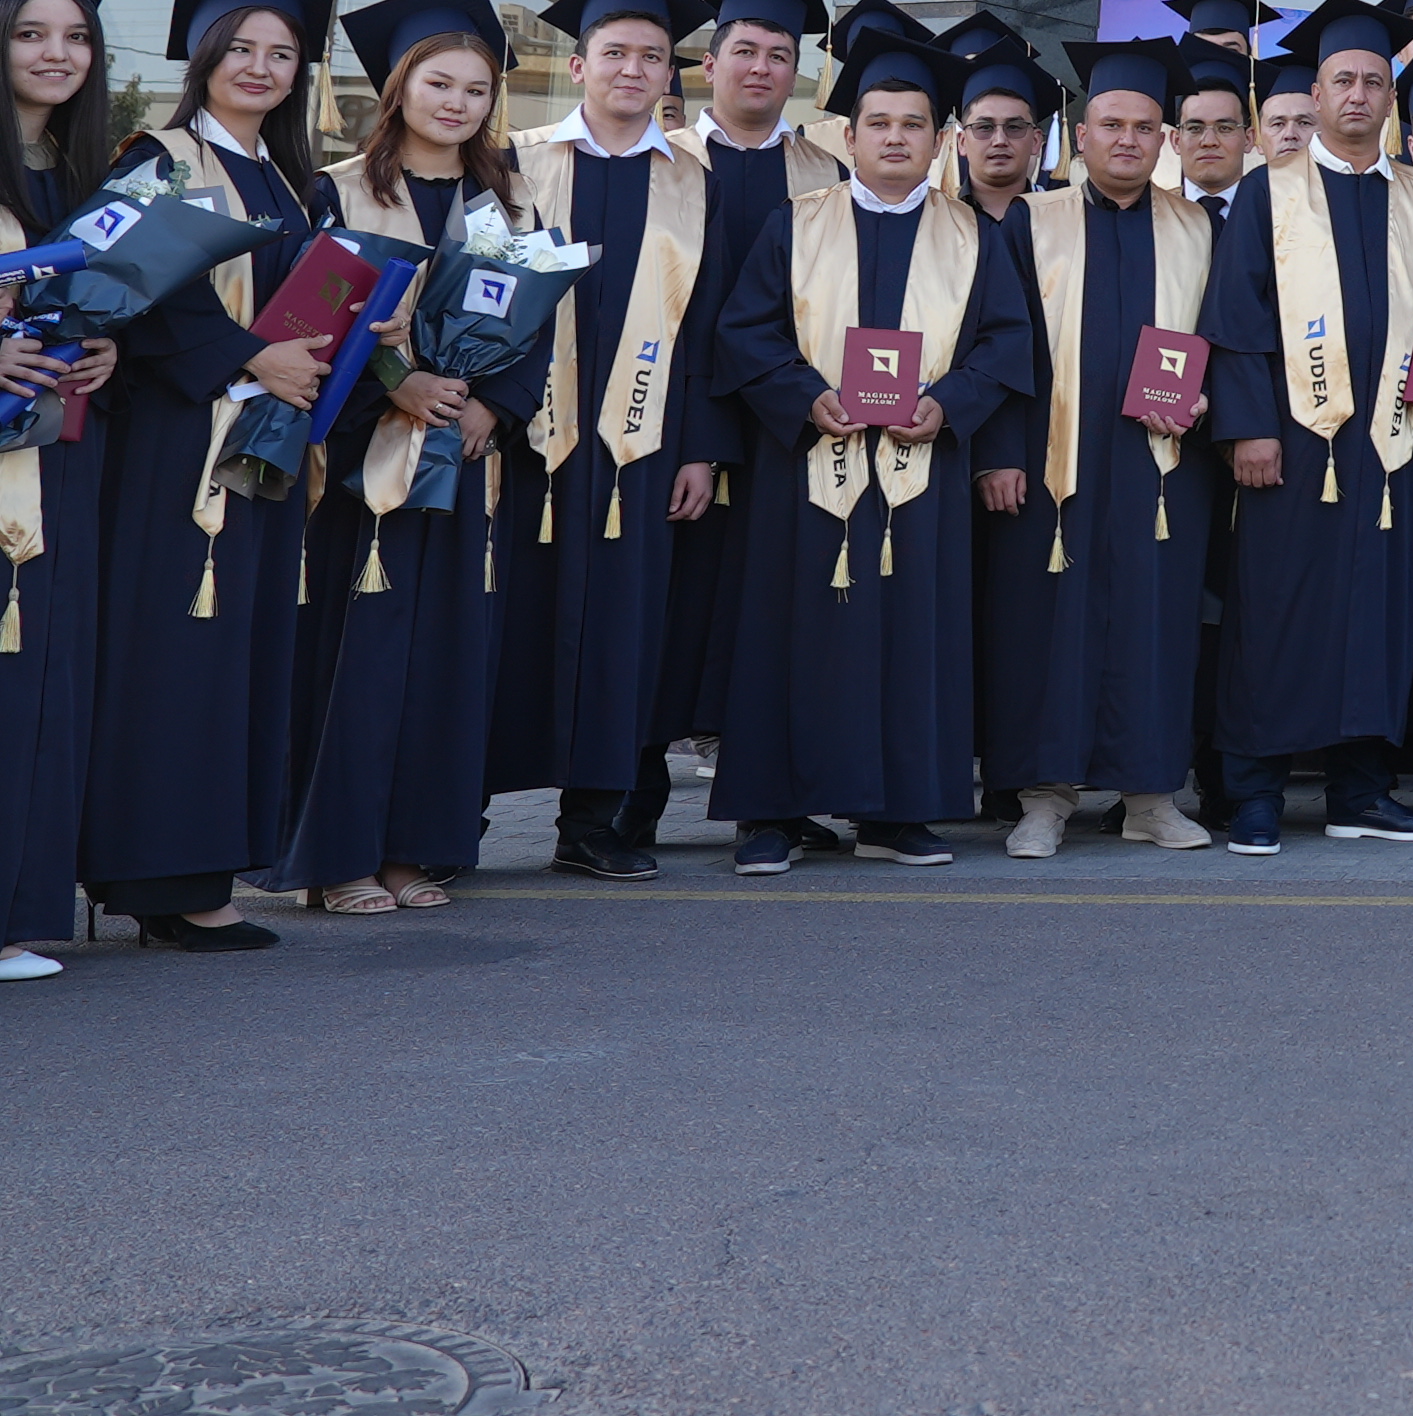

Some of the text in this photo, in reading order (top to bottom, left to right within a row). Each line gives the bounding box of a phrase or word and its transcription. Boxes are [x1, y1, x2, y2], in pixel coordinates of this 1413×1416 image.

[857, 391, 901, 400] MAGISTR
[1142, 387, 1182, 400] MAGISTR
[1309, 342, 1328, 409] UDEA
[623, 368, 652, 435] UDEA
[831, 437, 847, 489] DEA
[894, 444, 912, 472] EA
